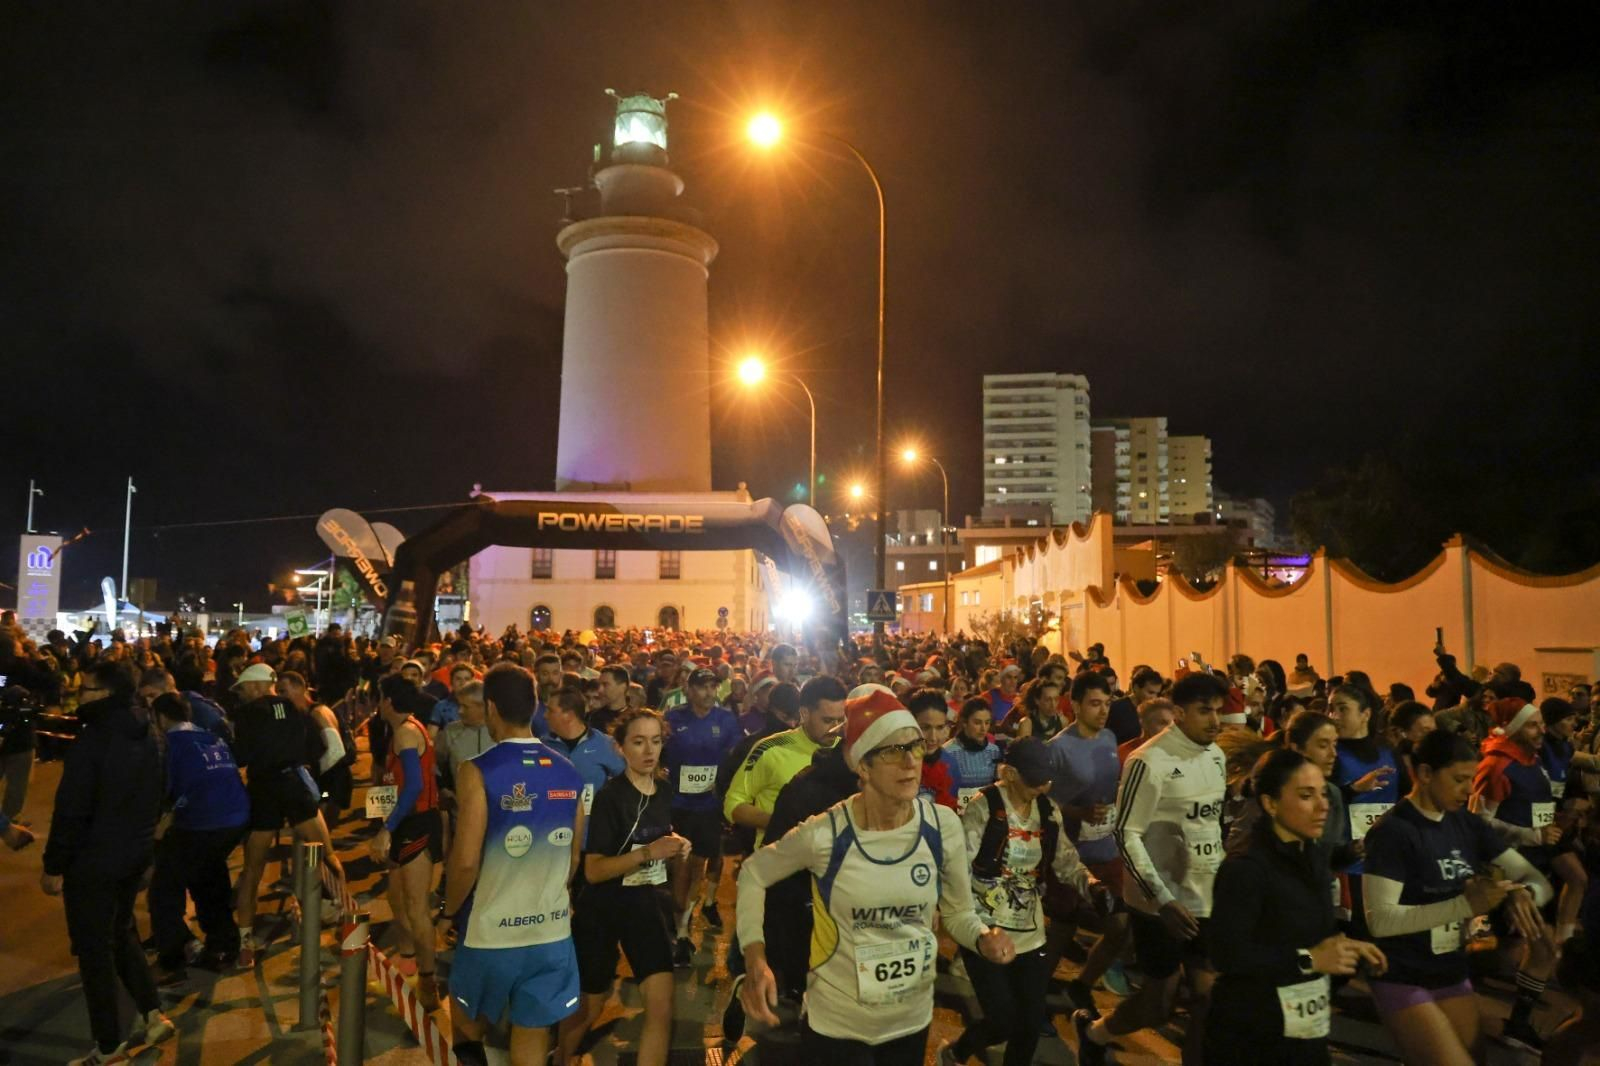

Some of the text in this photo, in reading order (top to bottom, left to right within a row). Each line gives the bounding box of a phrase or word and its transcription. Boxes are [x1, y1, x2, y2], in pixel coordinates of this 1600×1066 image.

[538, 512, 704, 533] POWERADE
[687, 774, 707, 782] 900
[498, 913, 545, 928] ALBERO
[851, 902, 928, 921] WITNEY
[875, 958, 916, 982] 625
